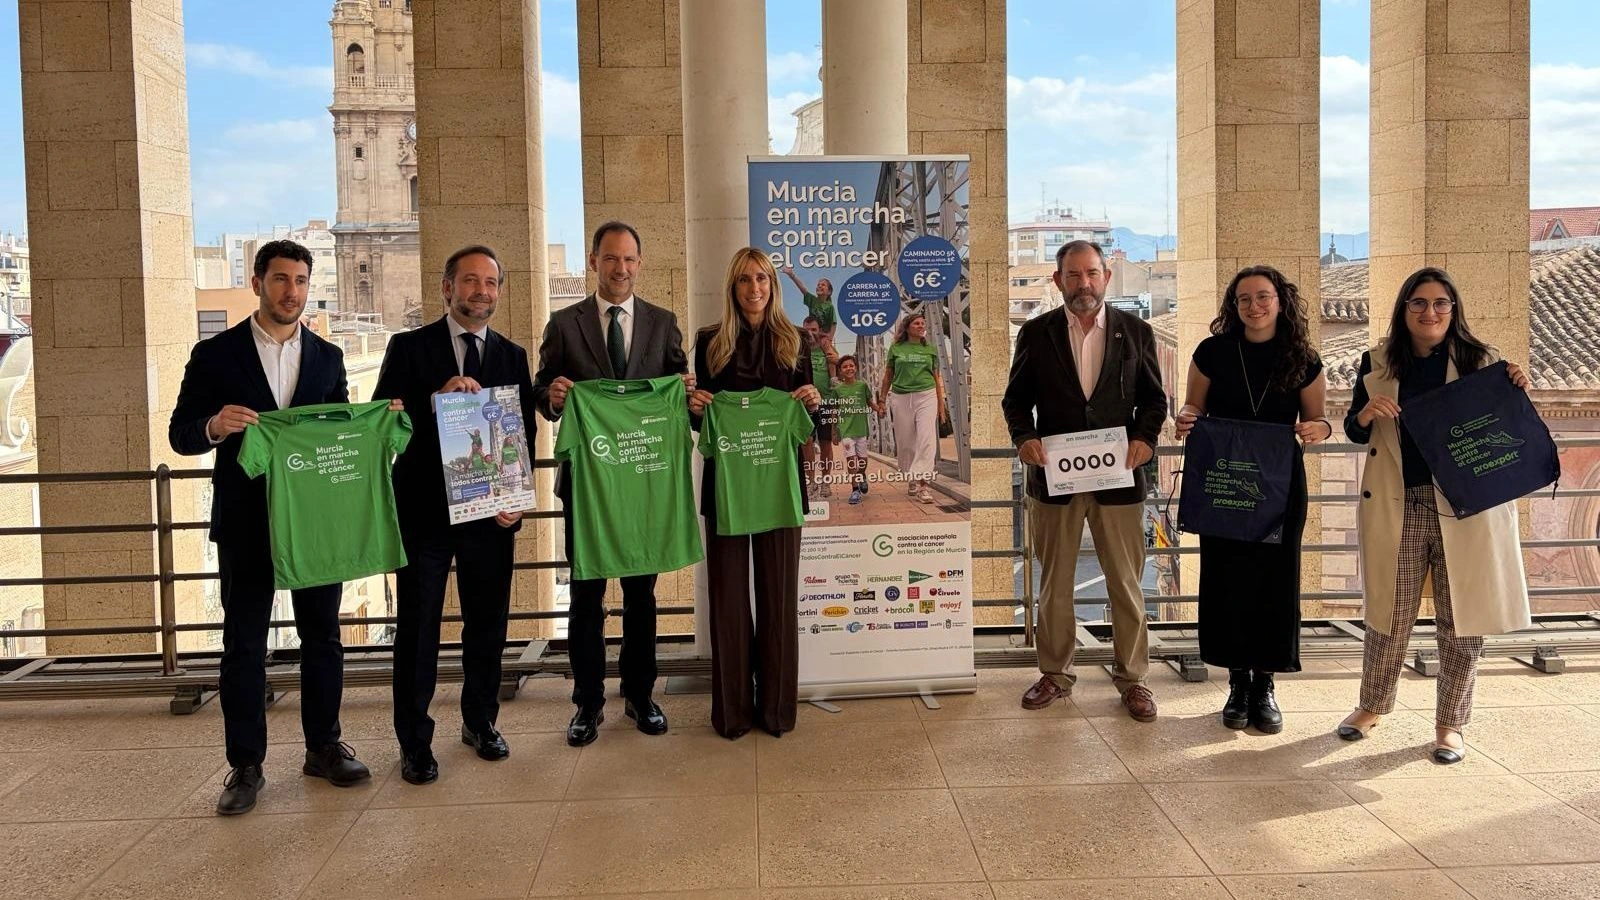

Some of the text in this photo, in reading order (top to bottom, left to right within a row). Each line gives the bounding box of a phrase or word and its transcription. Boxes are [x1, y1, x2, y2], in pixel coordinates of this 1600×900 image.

[767, 180, 856, 203] Murcia
[767, 202, 906, 225] en marcha
[767, 224, 853, 247] contra
[771, 246, 889, 268] el cáncer
[851, 312, 888, 327] 10€
[442, 396, 466, 404] Murcia
[444, 414, 468, 423] cáncer
[820, 416, 838, 424] 9:00
[616, 430, 646, 440] Murcia
[751, 435, 776, 443] marcha
[630, 435, 663, 446] marcha
[1447, 436, 1474, 450] Murcia
[1462, 437, 1490, 452] marcha
[316, 444, 344, 455] Murcia
[328, 449, 360, 460] marcha
[619, 446, 647, 456] contra
[750, 448, 774, 456] cáncer
[630, 452, 659, 462] cáncer
[1454, 449, 1479, 462] contra
[1466, 450, 1492, 464] cáncer
[317, 460, 344, 468] contra
[802, 456, 867, 472] archa de
[1058, 452, 1116, 472] 0000
[328, 463, 356, 474] cáncer
[814, 473, 865, 484] contra
[868, 470, 883, 482] el
[886, 469, 939, 482] cáncer
[1206, 470, 1230, 478] Murcia
[472, 475, 492, 484] contra
[1216, 476, 1242, 485] marcha
[914, 548, 935, 556] Región
[804, 576, 827, 584] Paloma
[854, 606, 879, 614] Cricket
[940, 601, 962, 610] enjoy!
